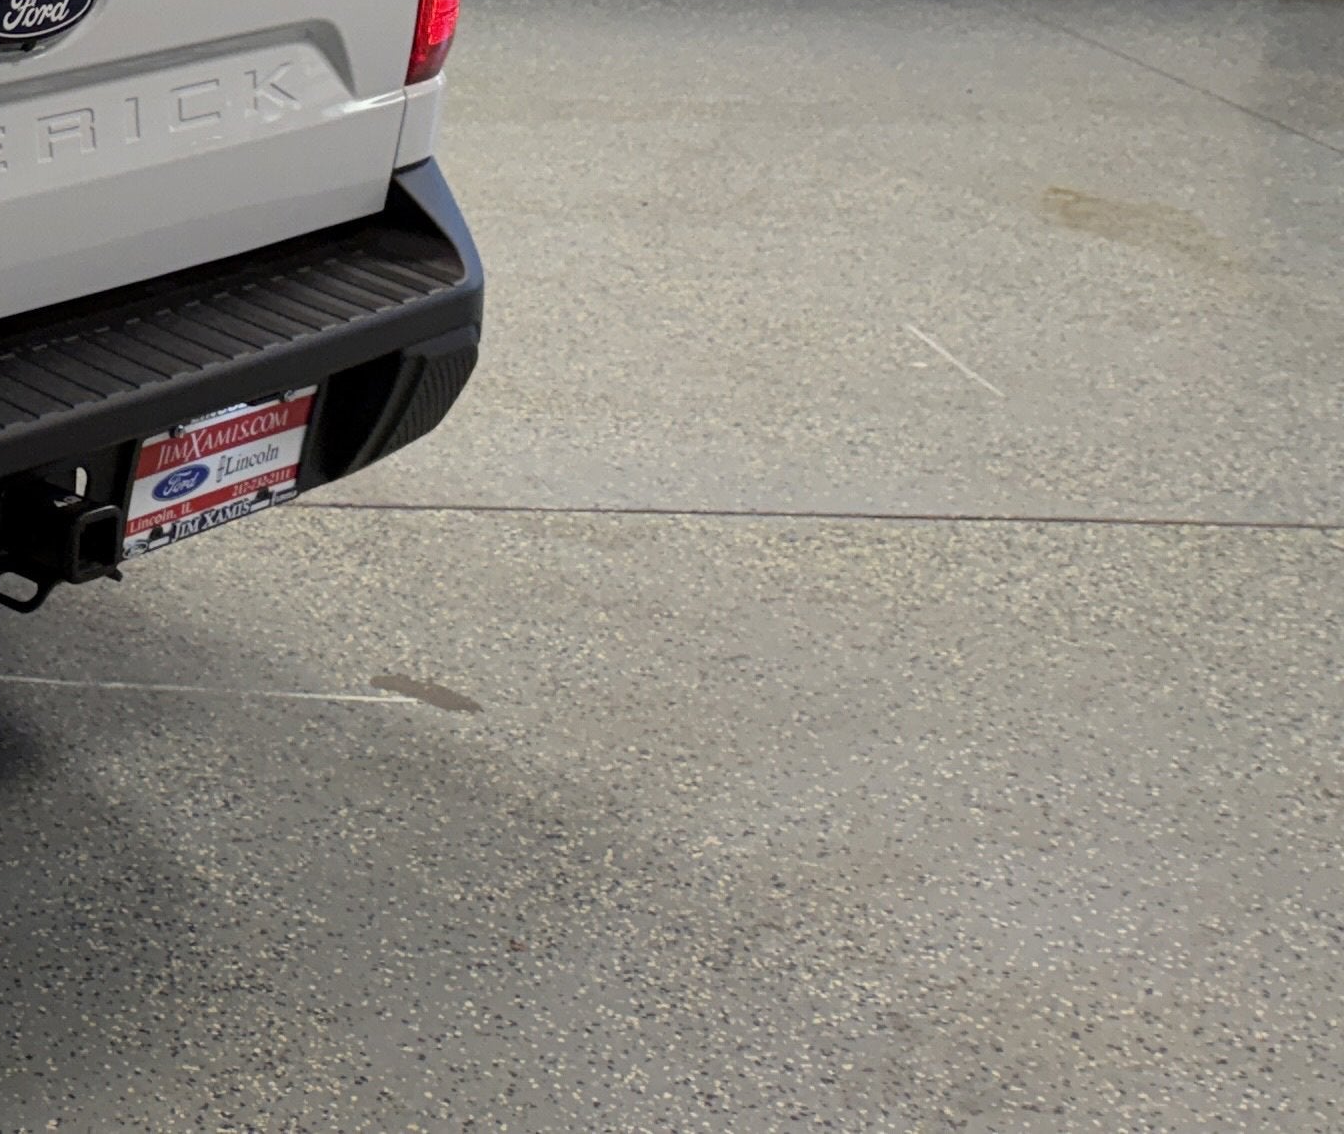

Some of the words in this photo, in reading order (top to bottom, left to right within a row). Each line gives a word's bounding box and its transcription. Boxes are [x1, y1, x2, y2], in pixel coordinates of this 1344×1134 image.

[224, 443, 280, 477] Lincoln
[162, 470, 201, 497] Ford
[129, 508, 177, 534] Lincoln,
